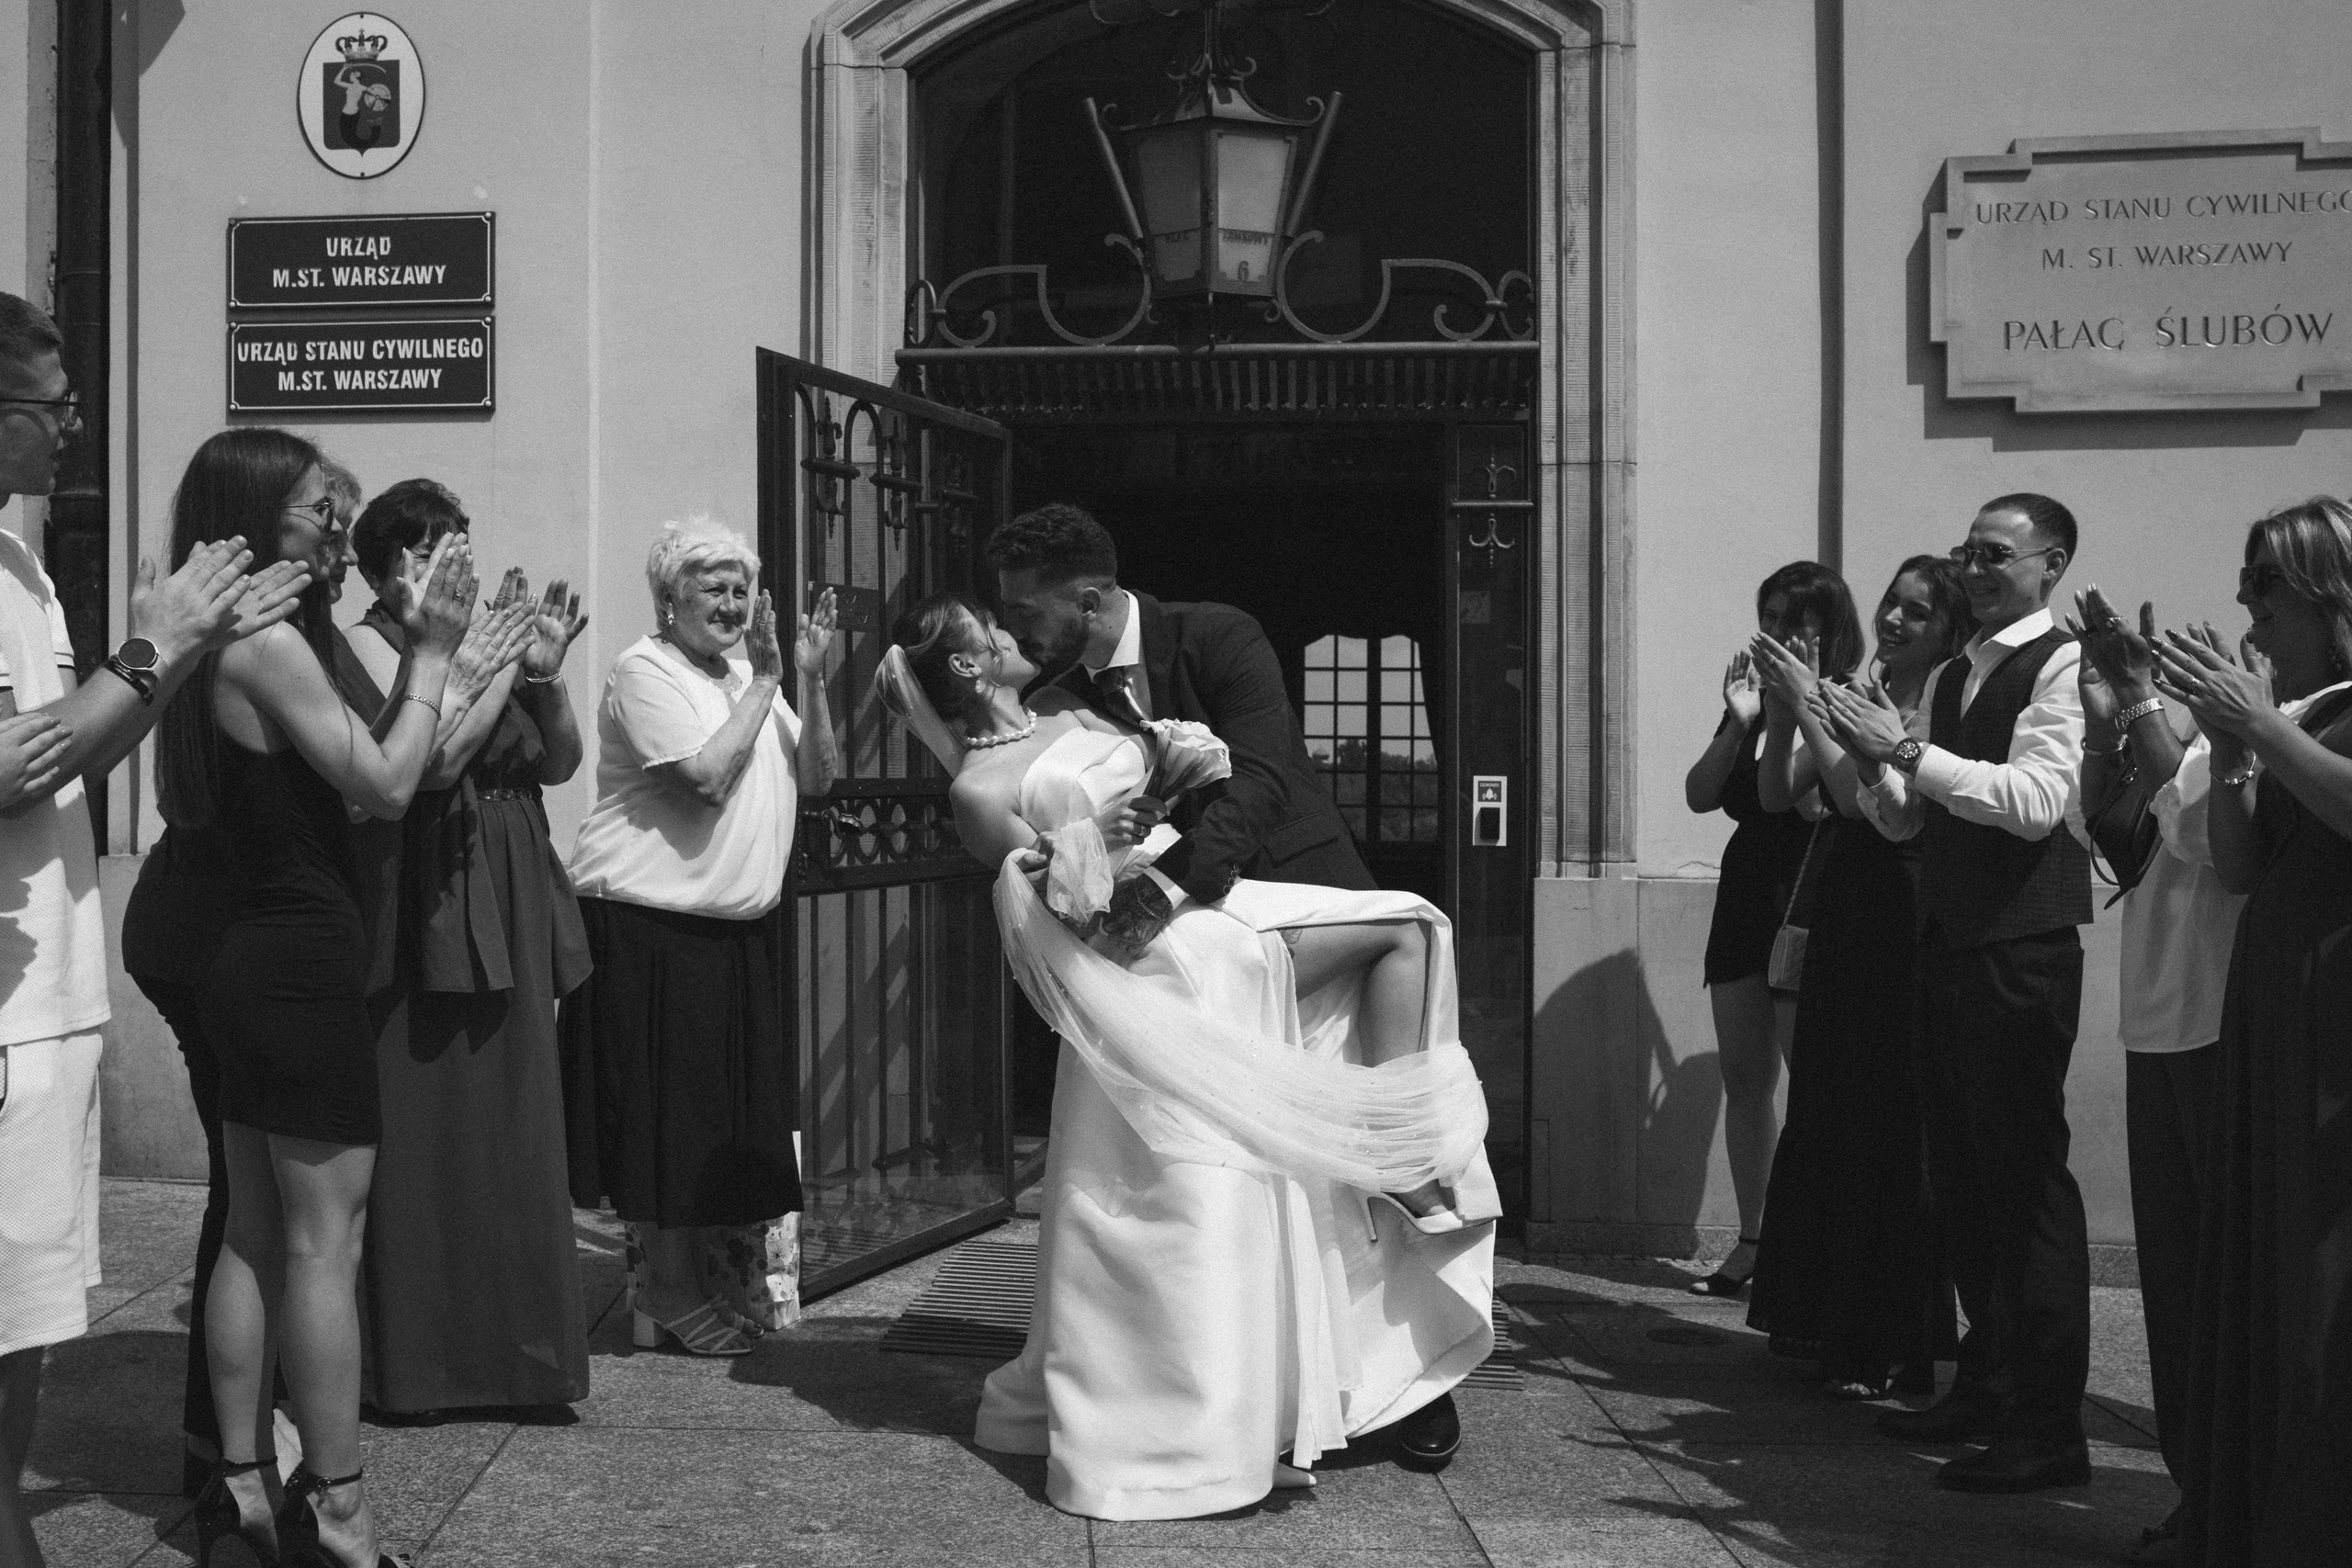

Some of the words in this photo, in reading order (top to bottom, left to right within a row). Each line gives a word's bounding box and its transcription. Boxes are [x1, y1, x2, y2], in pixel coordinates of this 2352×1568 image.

[1976, 199, 2069, 227] URZĄD
[2084, 196, 2171, 220] STANU
[326, 236, 391, 260] URZĄD
[2042, 247, 2074, 270] M.
[2088, 246, 2122, 269] ST.
[2134, 242, 2292, 267] WARSZAWY
[273, 267, 324, 288] M.ST.
[332, 265, 447, 287] WARSZAWY
[1238, 260, 1250, 283] 6
[2003, 317, 2125, 351] PAŁAC
[2155, 303, 2334, 348] ŚLUBÓW
[237, 341, 299, 366] URZĄD
[305, 340, 365, 361] STANU
[372, 337, 483, 359] CYWILNEGO
[278, 370, 327, 391] M.ST.
[334, 368, 443, 390] WARSZAWY
